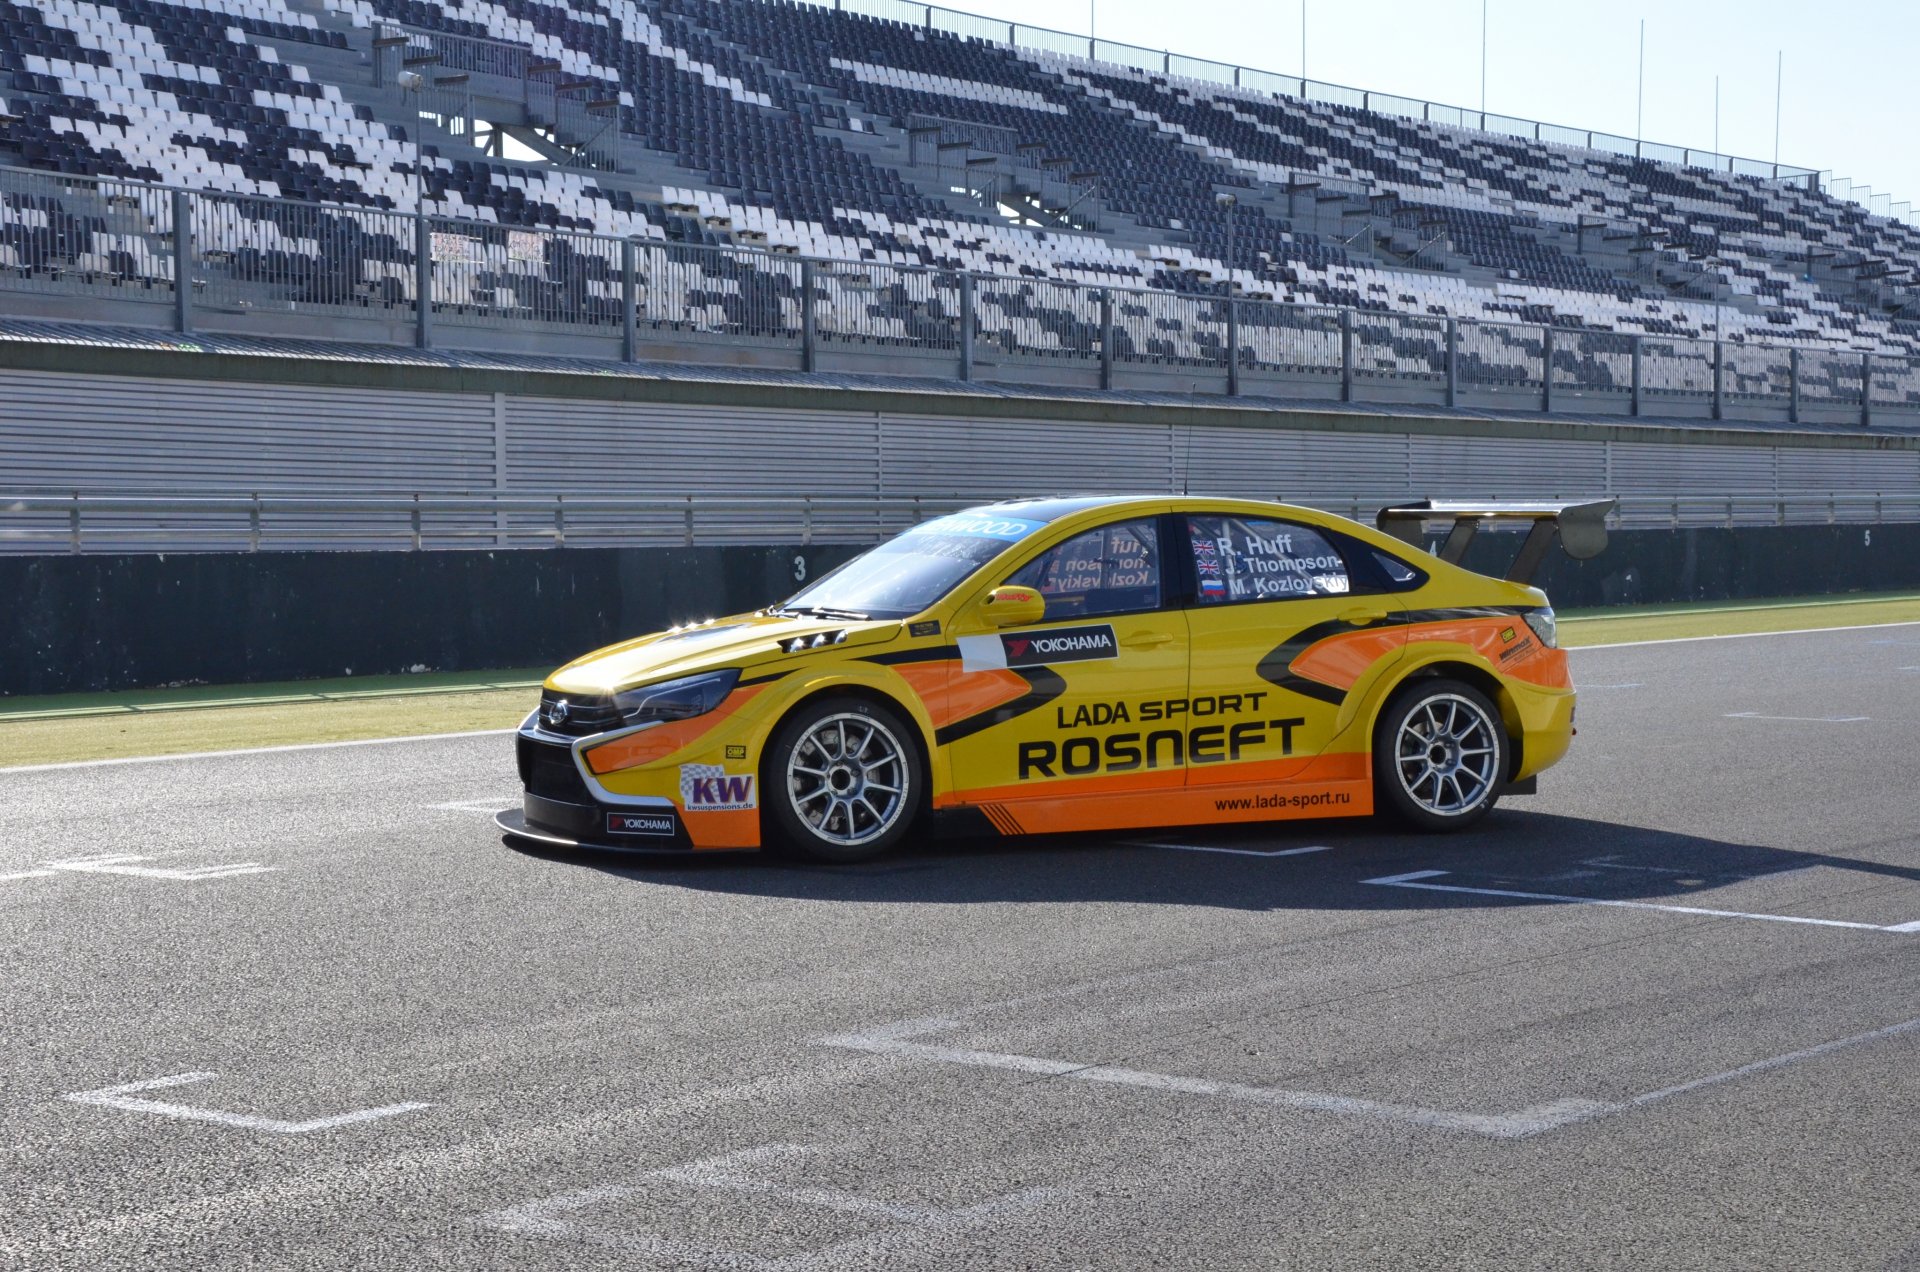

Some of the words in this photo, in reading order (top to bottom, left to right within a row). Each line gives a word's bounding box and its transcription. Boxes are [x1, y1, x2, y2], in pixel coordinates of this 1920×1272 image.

[1216, 537, 1242, 557] R.
[1245, 534, 1292, 555] Huff
[1864, 529, 1871, 546] 5
[794, 555, 806, 581] 3
[1225, 557, 1241, 575] J.
[1243, 555, 1339, 574] Thompson
[1228, 578, 1251, 595] M.
[1253, 571, 1348, 593] Kozlovskiy
[1030, 633, 1112, 654] YOKOHAMA
[1057, 701, 1130, 729] LADA
[1139, 692, 1268, 721] SPORT
[1018, 717, 1305, 780] ROSNEFT
[693, 776, 754, 804] KW
[1215, 791, 1350, 810] www.lada-sport.ru
[687, 802, 753, 811] kwsuspensions.de
[623, 818, 672, 830] YOKOHAMA
